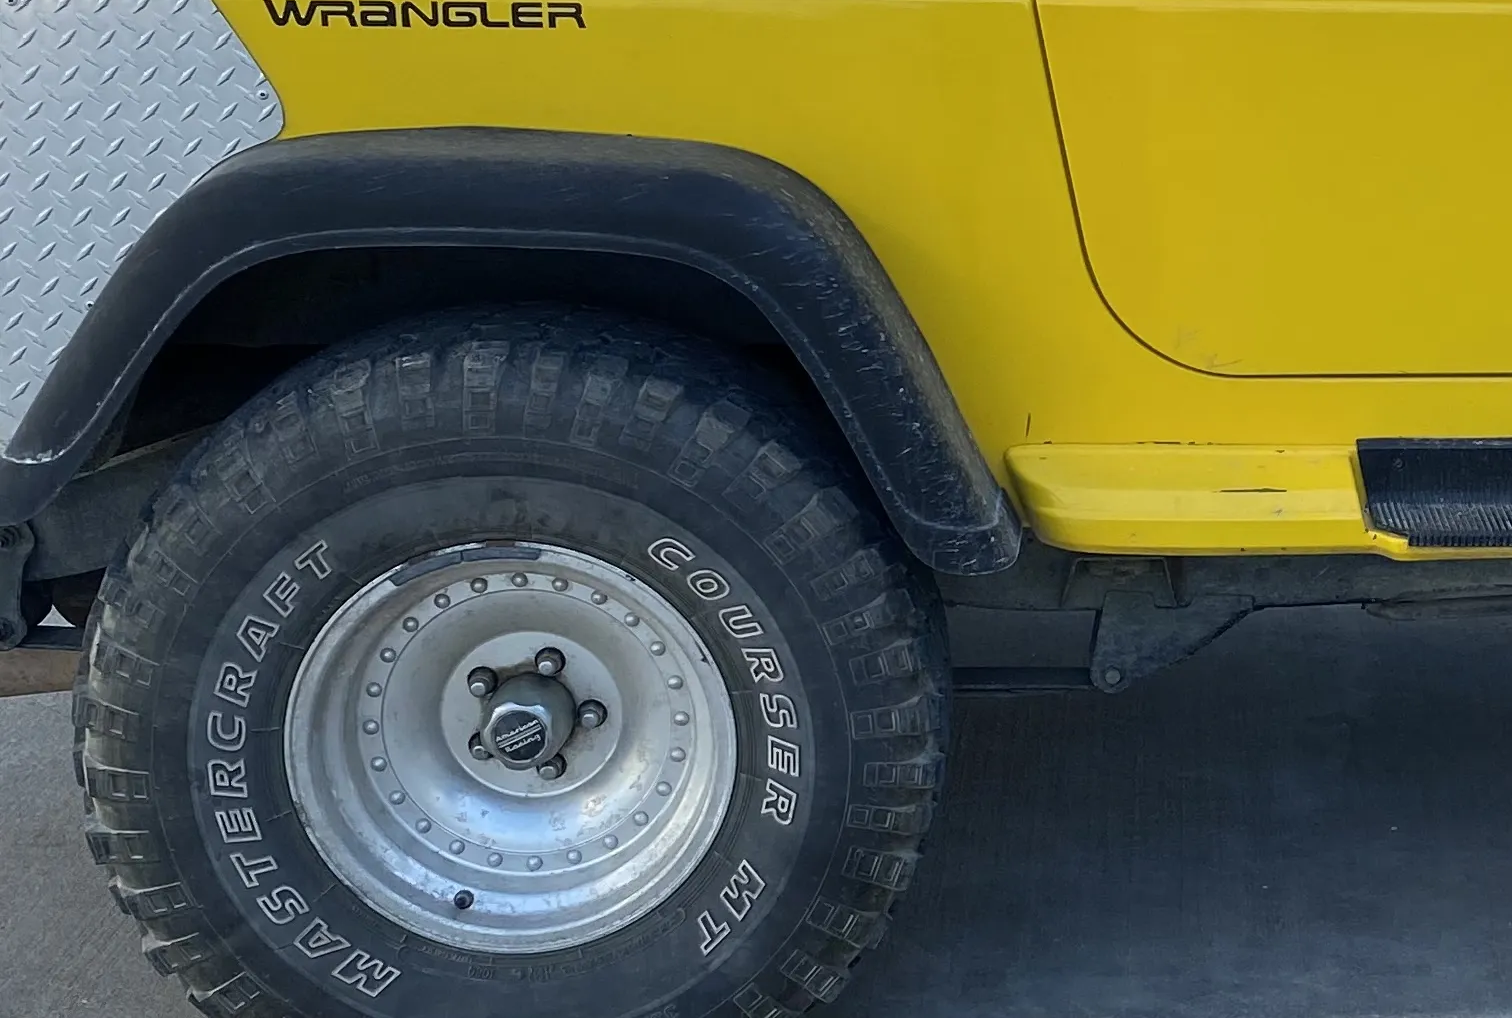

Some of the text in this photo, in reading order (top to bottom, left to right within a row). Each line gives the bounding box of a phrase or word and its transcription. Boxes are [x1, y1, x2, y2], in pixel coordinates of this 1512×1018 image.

[207, 539, 400, 998] MASTERCRAFT
[647, 537, 800, 956] COURSER MT
